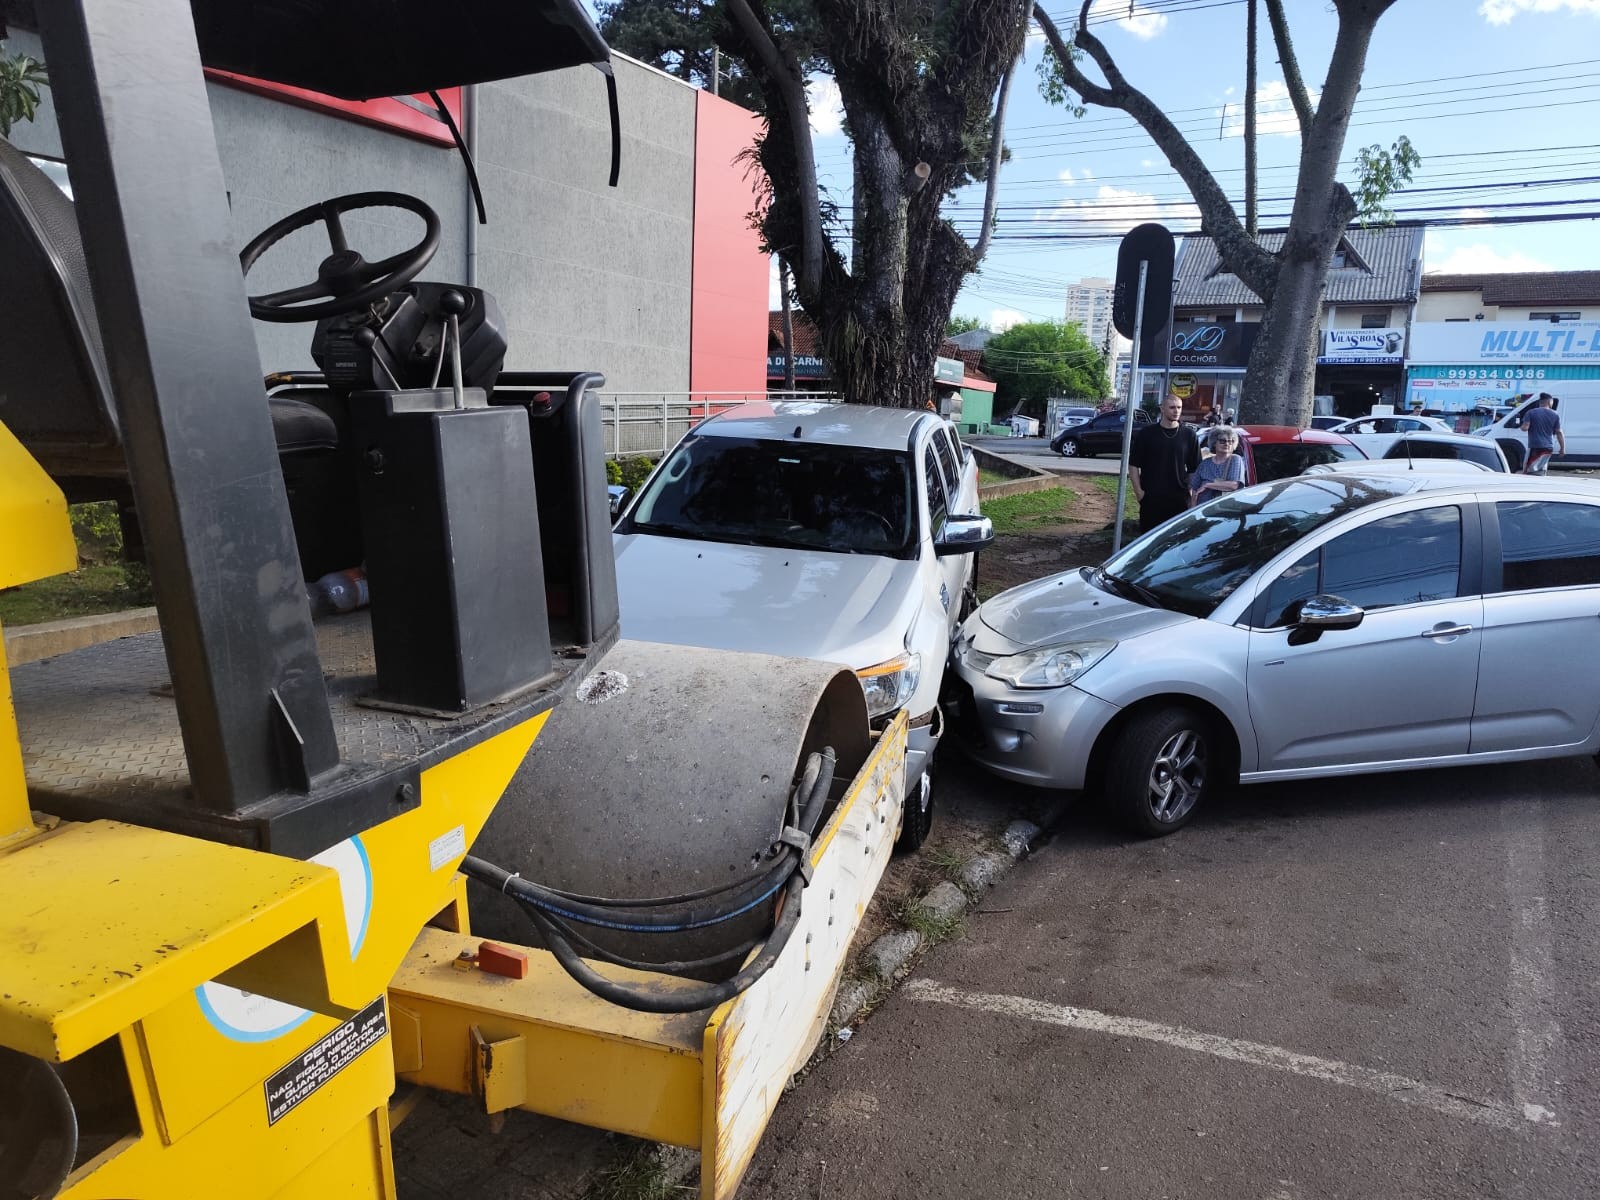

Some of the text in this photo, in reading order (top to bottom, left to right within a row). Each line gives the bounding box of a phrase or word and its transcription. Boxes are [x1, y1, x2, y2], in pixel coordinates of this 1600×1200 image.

[1448, 369, 1545, 379] 99934 0386
[284, 1028, 374, 1099] QUANDO O MOTOR
[295, 1056, 325, 1082] FIQUE
[327, 1032, 359, 1058] NESTA
[303, 1021, 355, 1066] PERIGO
[272, 1026, 385, 1117] ESTIVER FUNCIONANDO
